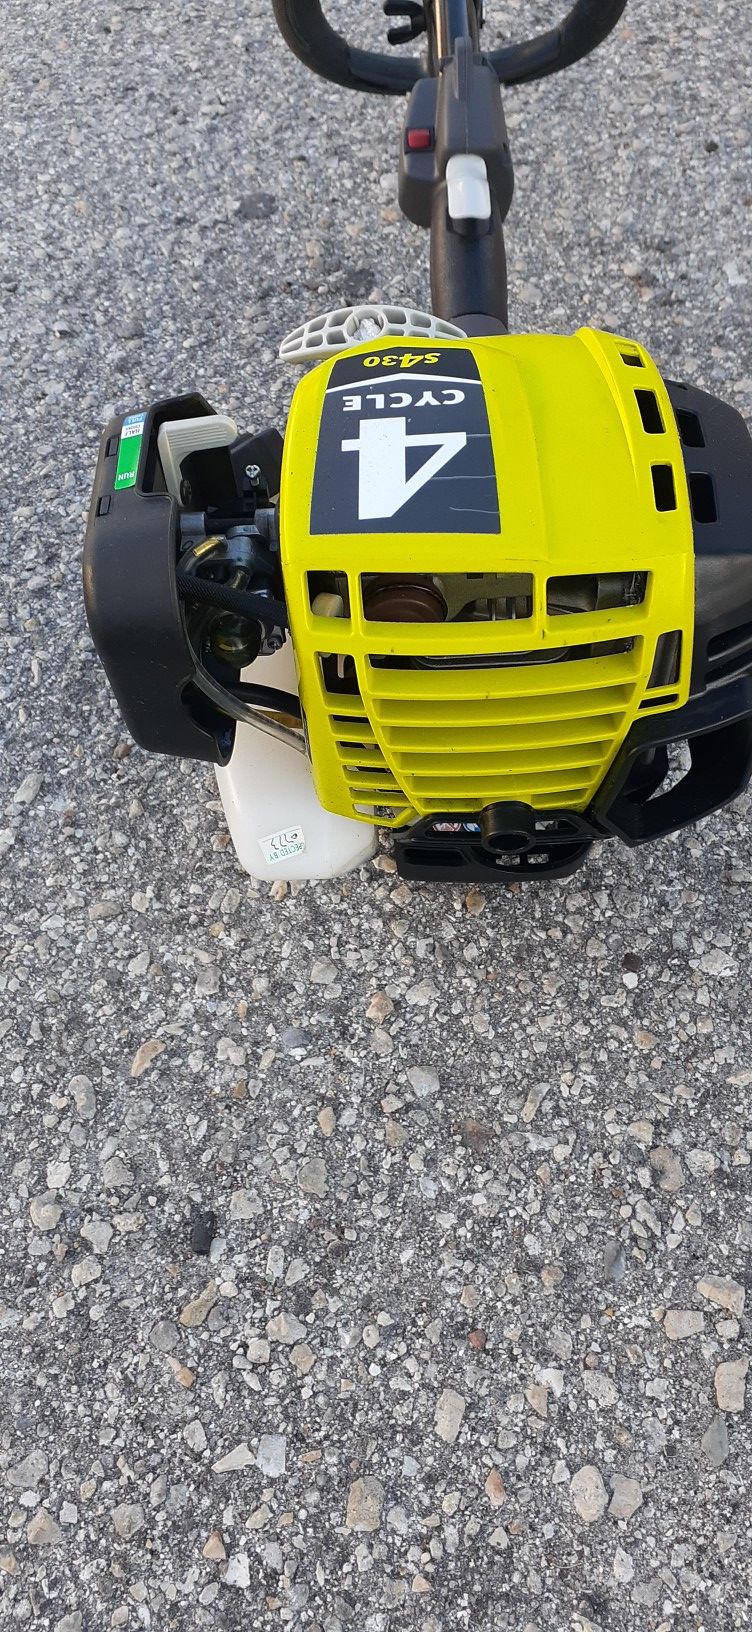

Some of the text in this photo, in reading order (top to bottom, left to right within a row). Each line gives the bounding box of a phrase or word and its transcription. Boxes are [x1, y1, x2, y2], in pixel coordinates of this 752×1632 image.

[363, 352, 442, 368] S430
[342, 389, 466, 412] CYCLE
[124, 428, 141, 437] HALF
[341, 416, 467, 521] 4
[117, 470, 136, 481] RUN
[269, 851, 279, 861] BY
